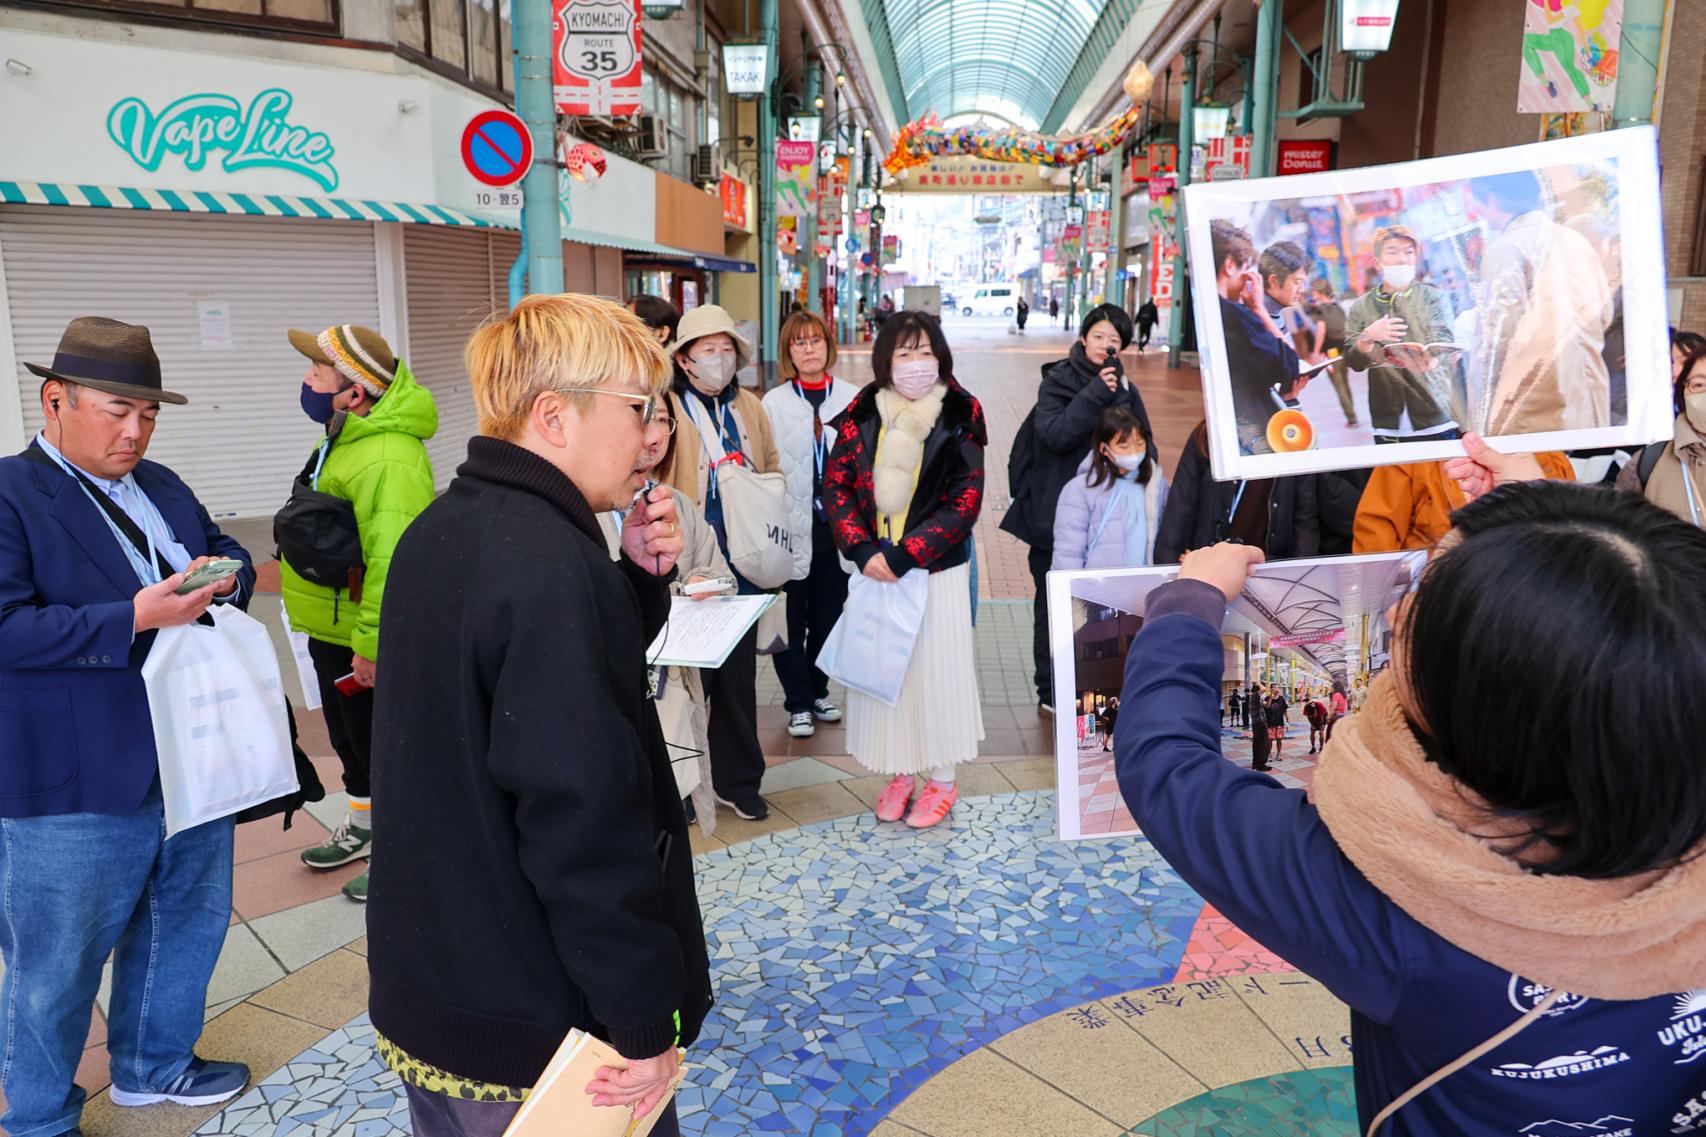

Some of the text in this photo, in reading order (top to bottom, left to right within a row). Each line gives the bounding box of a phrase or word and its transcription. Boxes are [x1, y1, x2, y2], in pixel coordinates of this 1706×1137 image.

[571, 12, 625, 28] KYOMACHI
[584, 39, 614, 48] ROUTE
[580, 51, 618, 72] 35
[780, 146, 810, 156] ENJOY
[1283, 149, 1324, 159] mister
[1282, 160, 1324, 169] Donut
[1656, 1014, 1706, 1047] UKU
[1490, 1051, 1631, 1079] KUJUKUSHIMA
